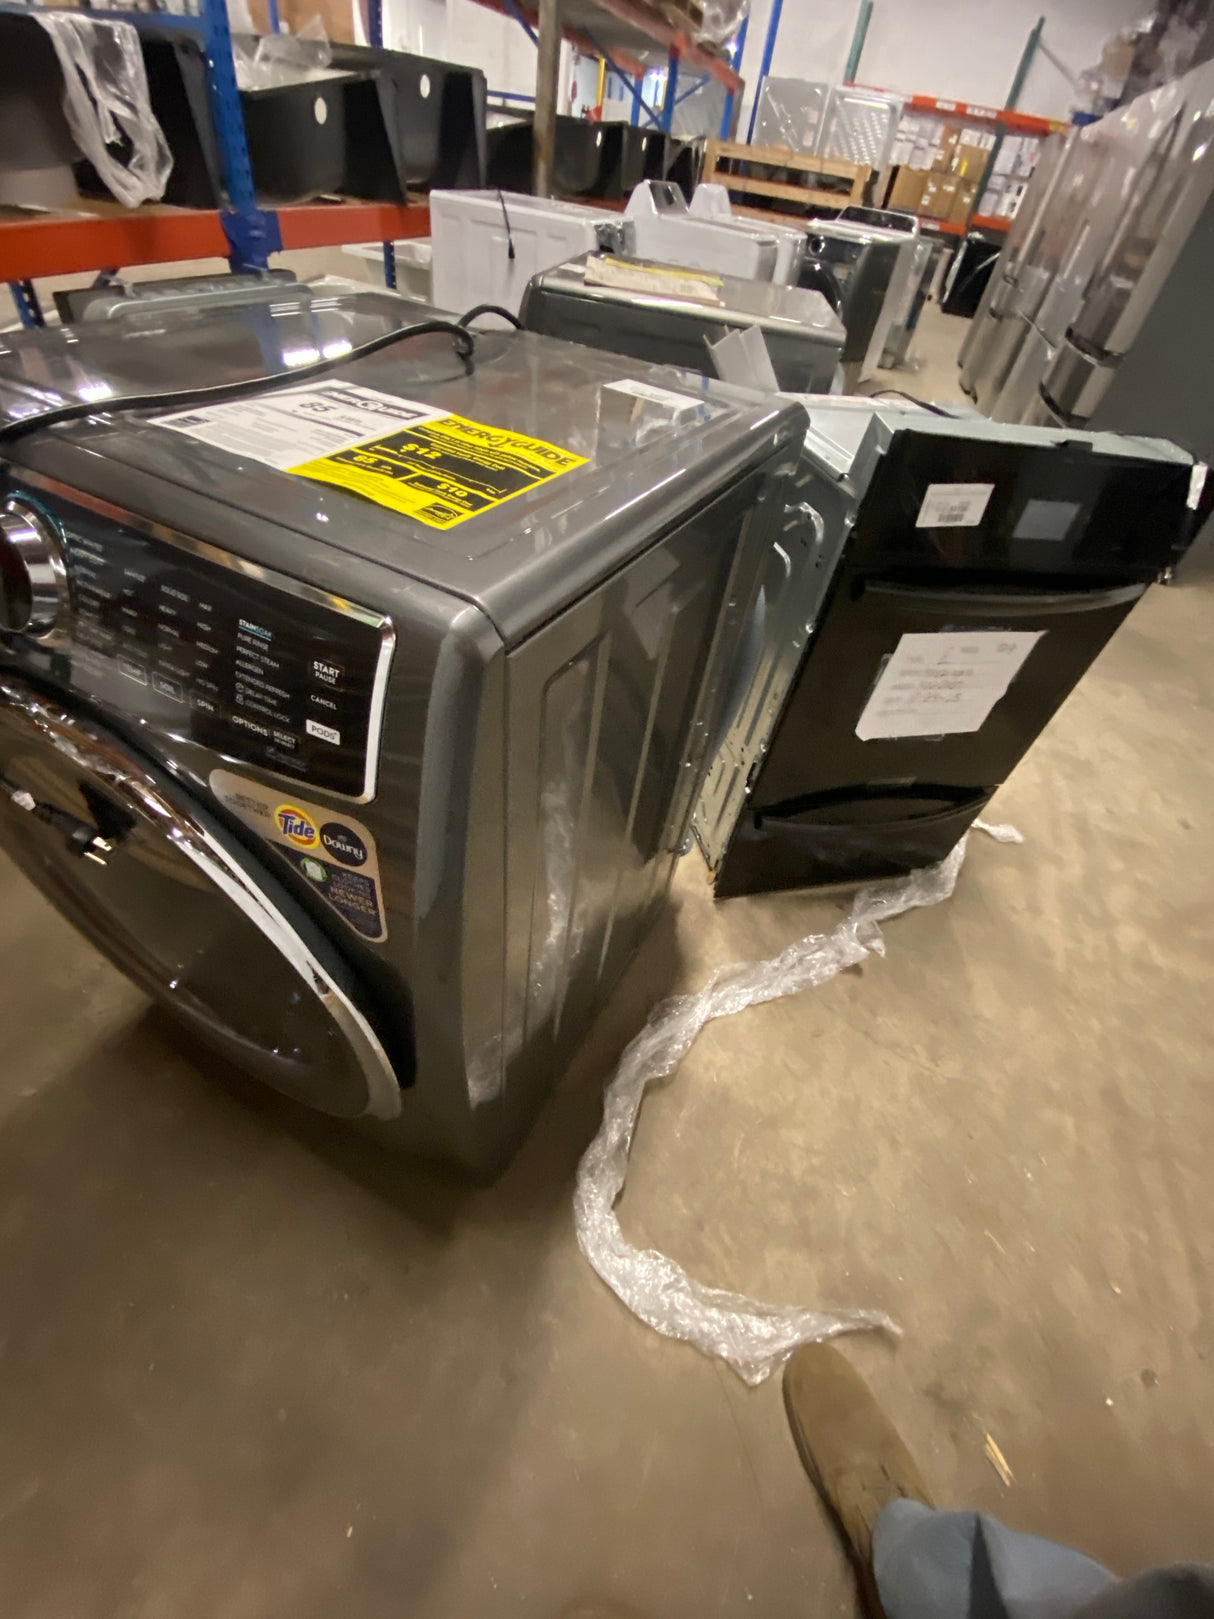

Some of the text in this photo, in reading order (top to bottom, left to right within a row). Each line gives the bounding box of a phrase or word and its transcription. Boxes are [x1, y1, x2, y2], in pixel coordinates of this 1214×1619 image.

[299, 402, 338, 412] 85
[439, 418, 576, 466] ENERGYGUIDE
[400, 443, 442, 460] $12
[437, 482, 468, 497] $10
[235, 659, 264, 676] ALLERGEN
[260, 654, 280, 669] STEAM
[313, 660, 341, 678] START
[315, 670, 337, 685] PAUSE
[197, 698, 215, 712] SPIN
[310, 694, 338, 710] CANCEL
[273, 710, 291, 723] LOCK
[232, 715, 268, 737] OPTIONS
[311, 724, 336, 741] PODS
[273, 729, 296, 745] SELECT
[278, 813, 315, 839] Tide
[323, 834, 364, 860] Downy
[330, 886, 373, 908] NEWER
